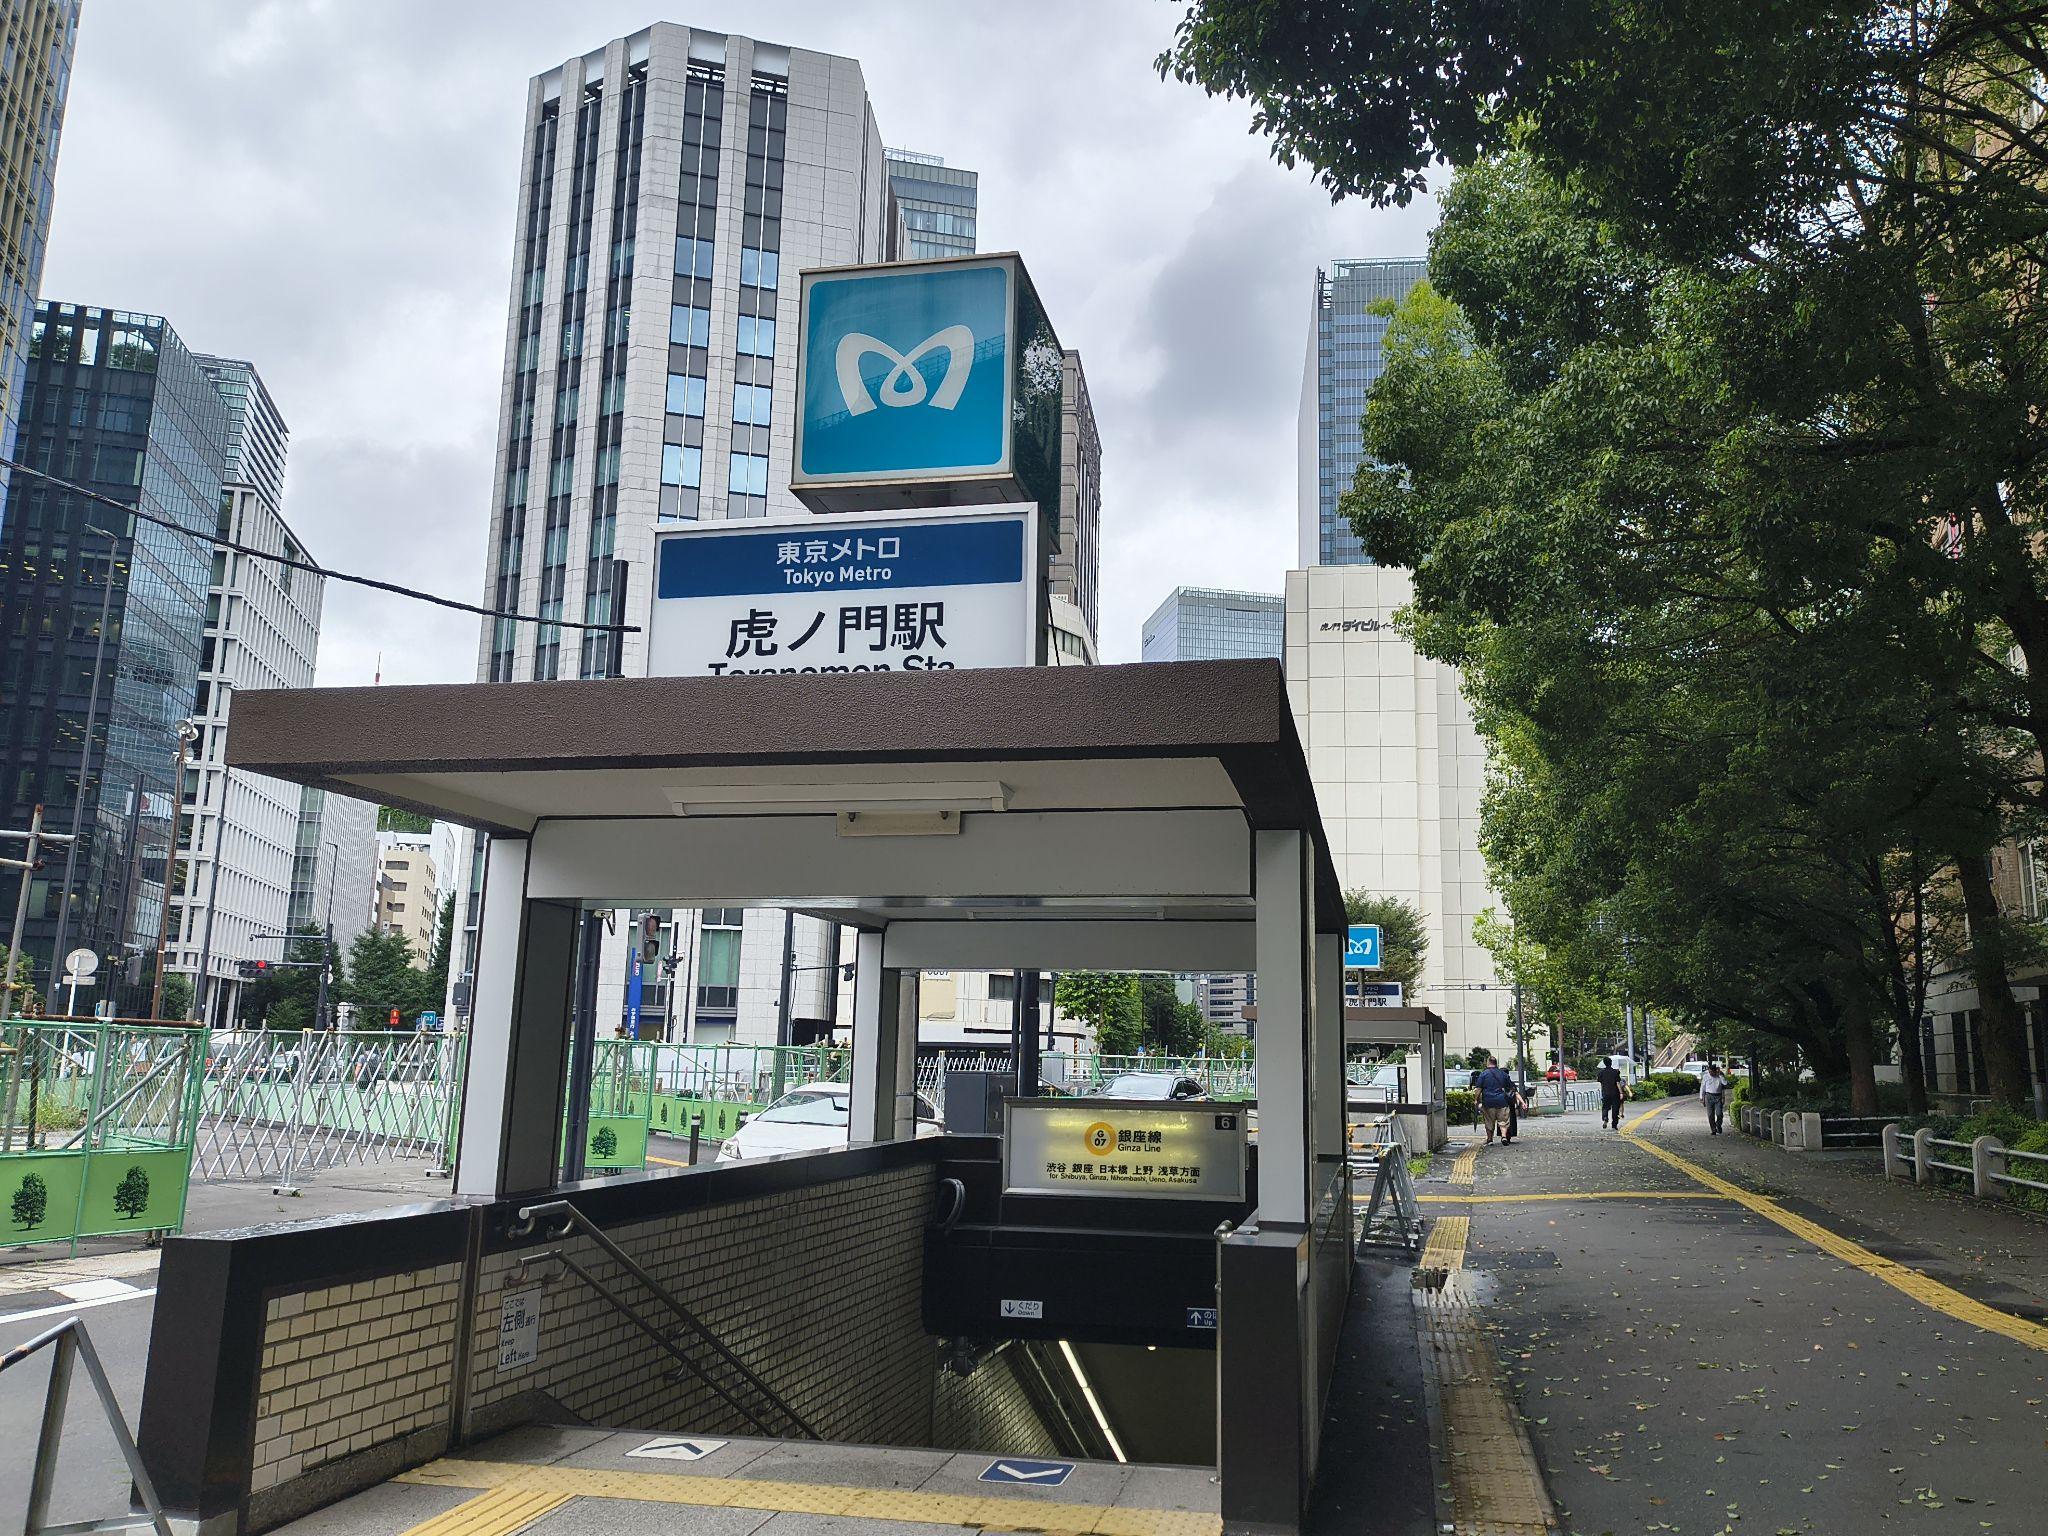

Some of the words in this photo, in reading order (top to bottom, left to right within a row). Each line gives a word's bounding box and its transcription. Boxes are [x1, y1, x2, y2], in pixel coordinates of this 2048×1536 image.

[776, 537, 900, 565] 東京メトロ
[783, 568, 834, 587] Tokyo
[839, 566, 892, 582] Metro
[725, 601, 947, 659] 虎ノ門駅
[1221, 1116, 1230, 1129] 6
[1097, 1130, 1104, 1138] G
[1118, 1129, 1162, 1144] 銀座線
[1094, 1138, 1106, 1147] 07
[1118, 1143, 1141, 1152] Ginza
[1144, 1143, 1161, 1152] Line
[1046, 1162, 1067, 1173] 渋谷
[1072, 1163, 1094, 1174] 銀座
[1099, 1164, 1128, 1175] 日本橋
[1132, 1165, 1154, 1176] 上野
[1158, 1166, 1201, 1178] 浅草方面
[1060, 1173, 1088, 1181] Shibuya,
[1110, 1174, 1147, 1182] Nihombashi,
[1168, 1176, 1197, 1184] Asakusa
[504, 1298, 525, 1310] ここでは
[1018, 1302, 1040, 1311] くだり
[500, 1348, 517, 1365] Left
